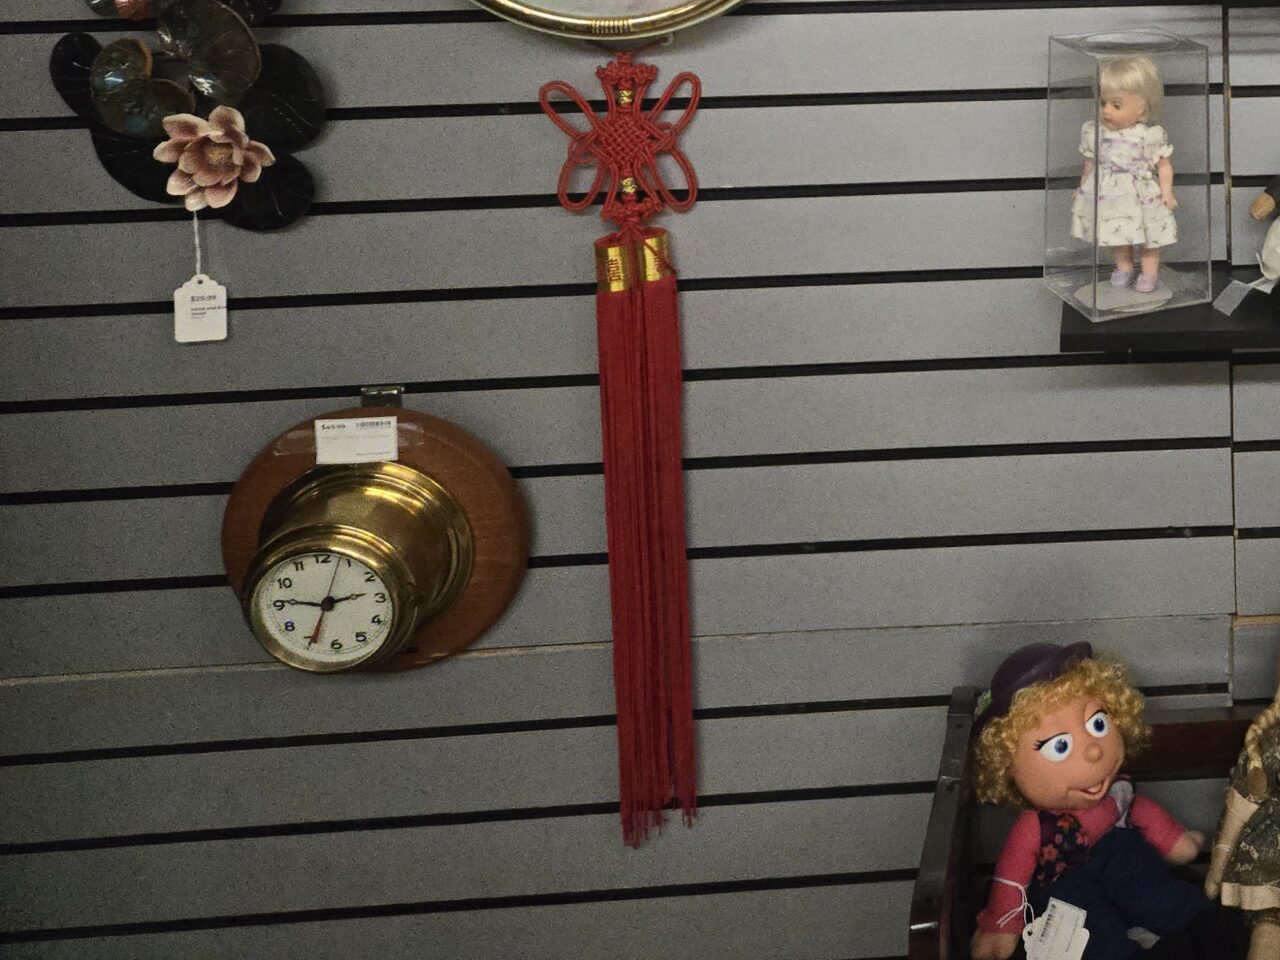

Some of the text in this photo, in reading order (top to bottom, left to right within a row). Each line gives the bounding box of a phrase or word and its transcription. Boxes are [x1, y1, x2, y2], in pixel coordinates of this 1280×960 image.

[313, 554, 332, 564] 12
[345, 558, 352, 567] 1
[293, 561, 305, 571] 11
[364, 571, 376, 583] 2
[277, 577, 293, 589] 10
[374, 592, 387, 603] 3
[273, 600, 286, 611] 9
[371, 614, 383, 625] 4
[284, 621, 296, 632] 8
[355, 632, 367, 642] 5
[330, 639, 343, 650] 6
